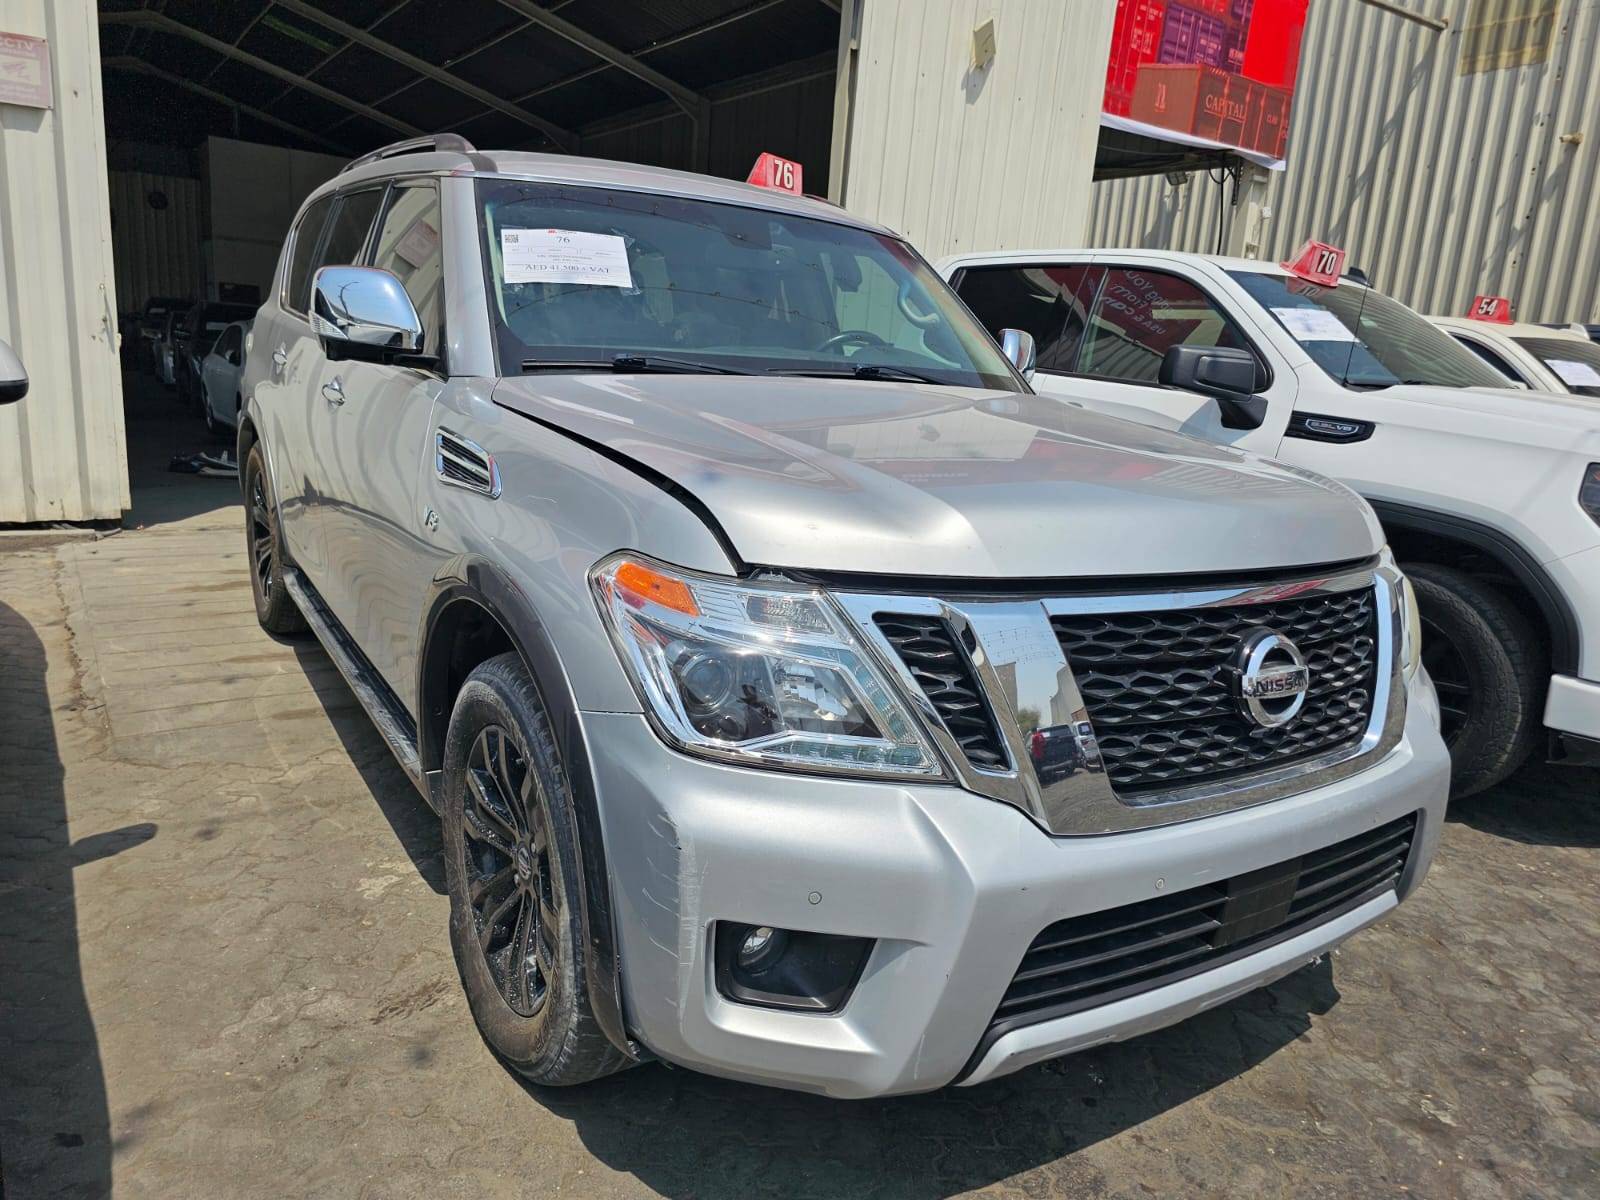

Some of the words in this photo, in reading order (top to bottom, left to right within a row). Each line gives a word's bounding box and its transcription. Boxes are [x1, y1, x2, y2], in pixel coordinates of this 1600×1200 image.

[1205, 93, 1246, 120] CAPITAL
[774, 159, 794, 189] 76
[556, 236, 571, 244] 76
[524, 263, 548, 271] AED
[1316, 250, 1338, 275] 70
[1478, 298, 1499, 316] 54
